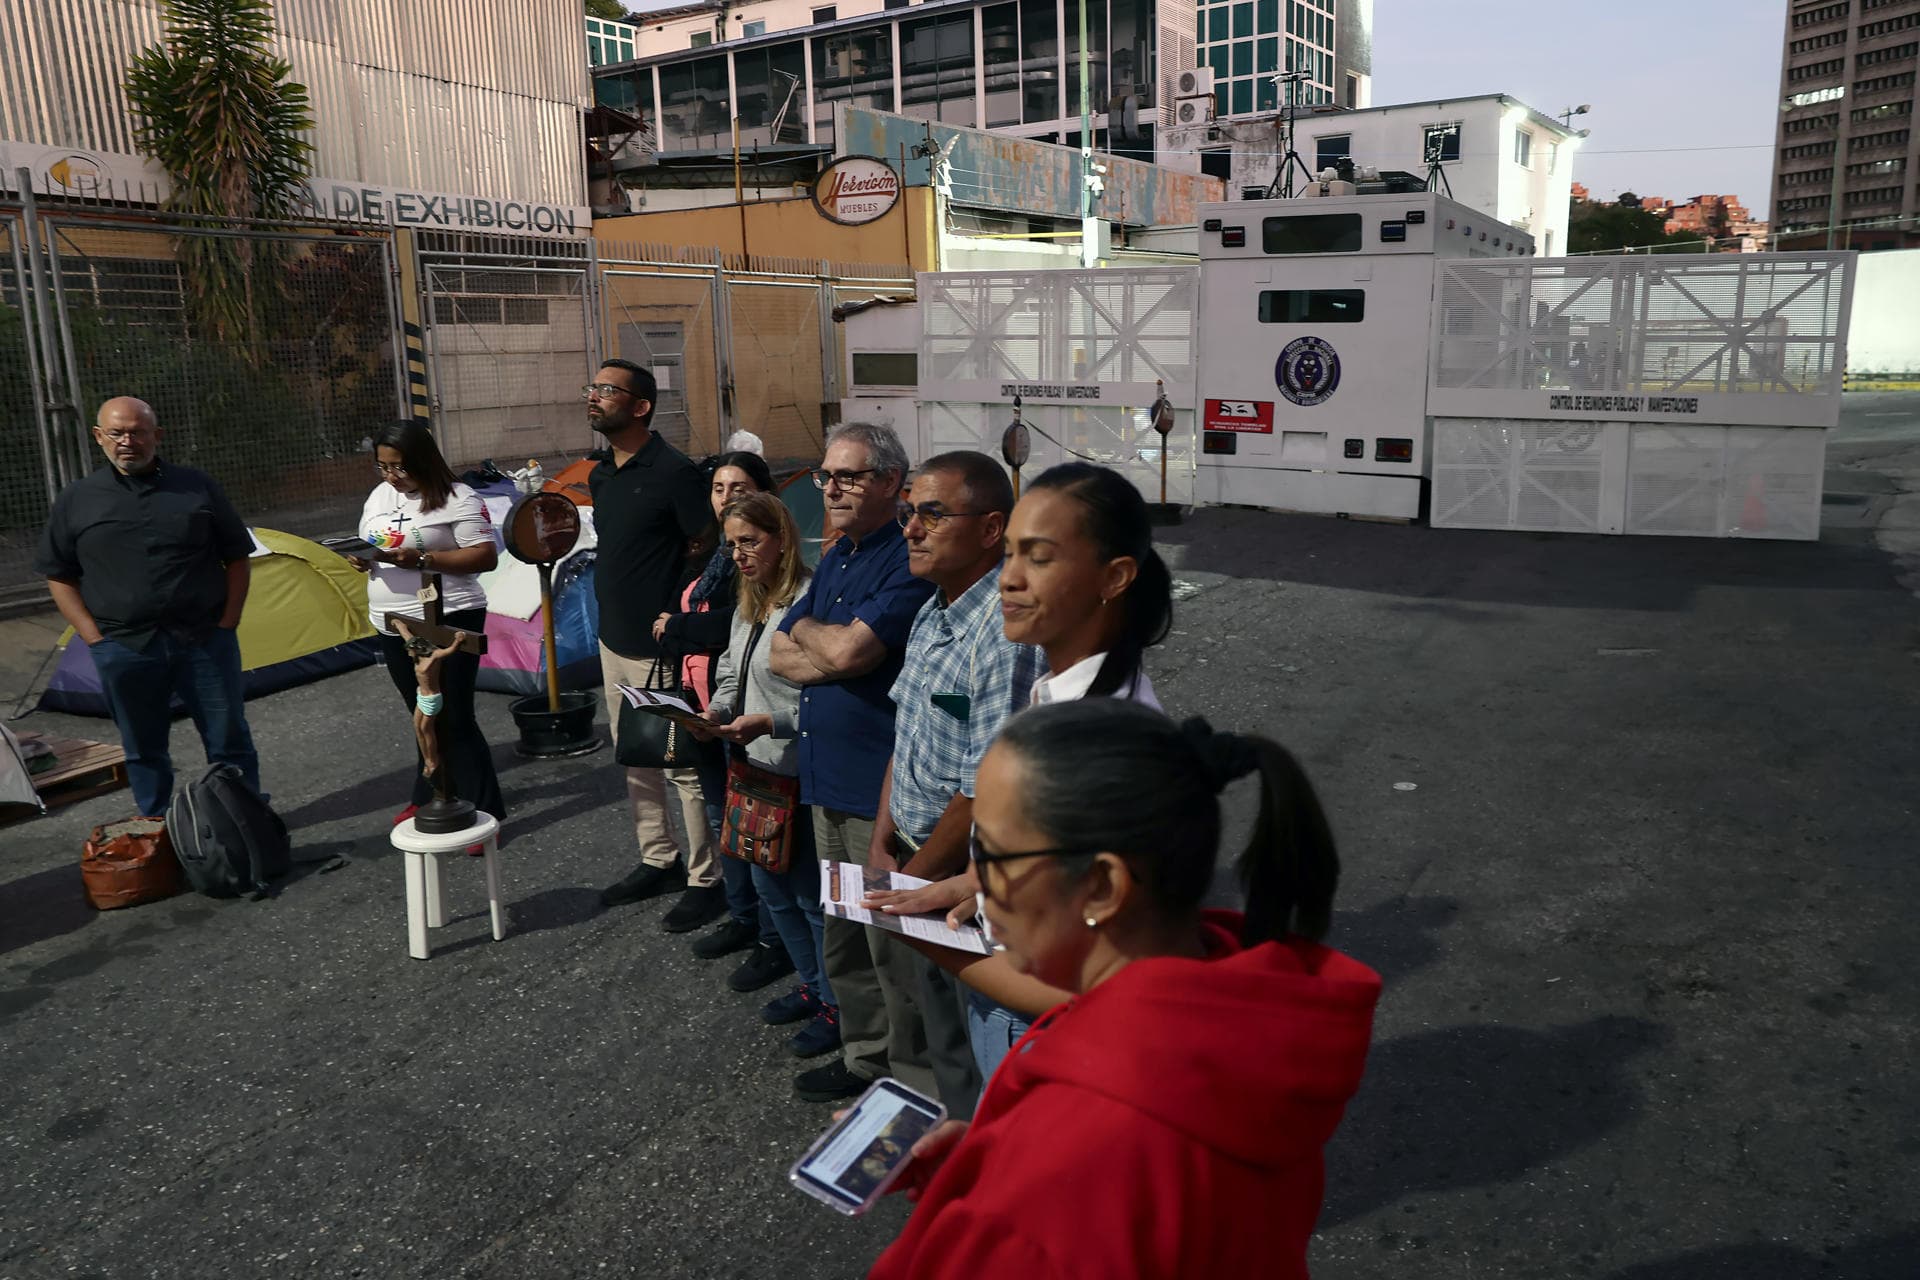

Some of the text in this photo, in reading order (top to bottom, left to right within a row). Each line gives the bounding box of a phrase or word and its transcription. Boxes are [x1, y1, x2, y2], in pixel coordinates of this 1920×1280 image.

[331, 185, 385, 221] DE
[395, 192, 575, 235] EXHIBICION
[840, 203, 878, 214] MUEBLES
[1001, 385, 1016, 397] CONTROL
[1550, 395, 1573, 410] CONTROL
[1575, 395, 1582, 410] DE
[1583, 395, 1613, 411] REUNIONES
[1648, 397, 1698, 414] MANIFESTACIONES
